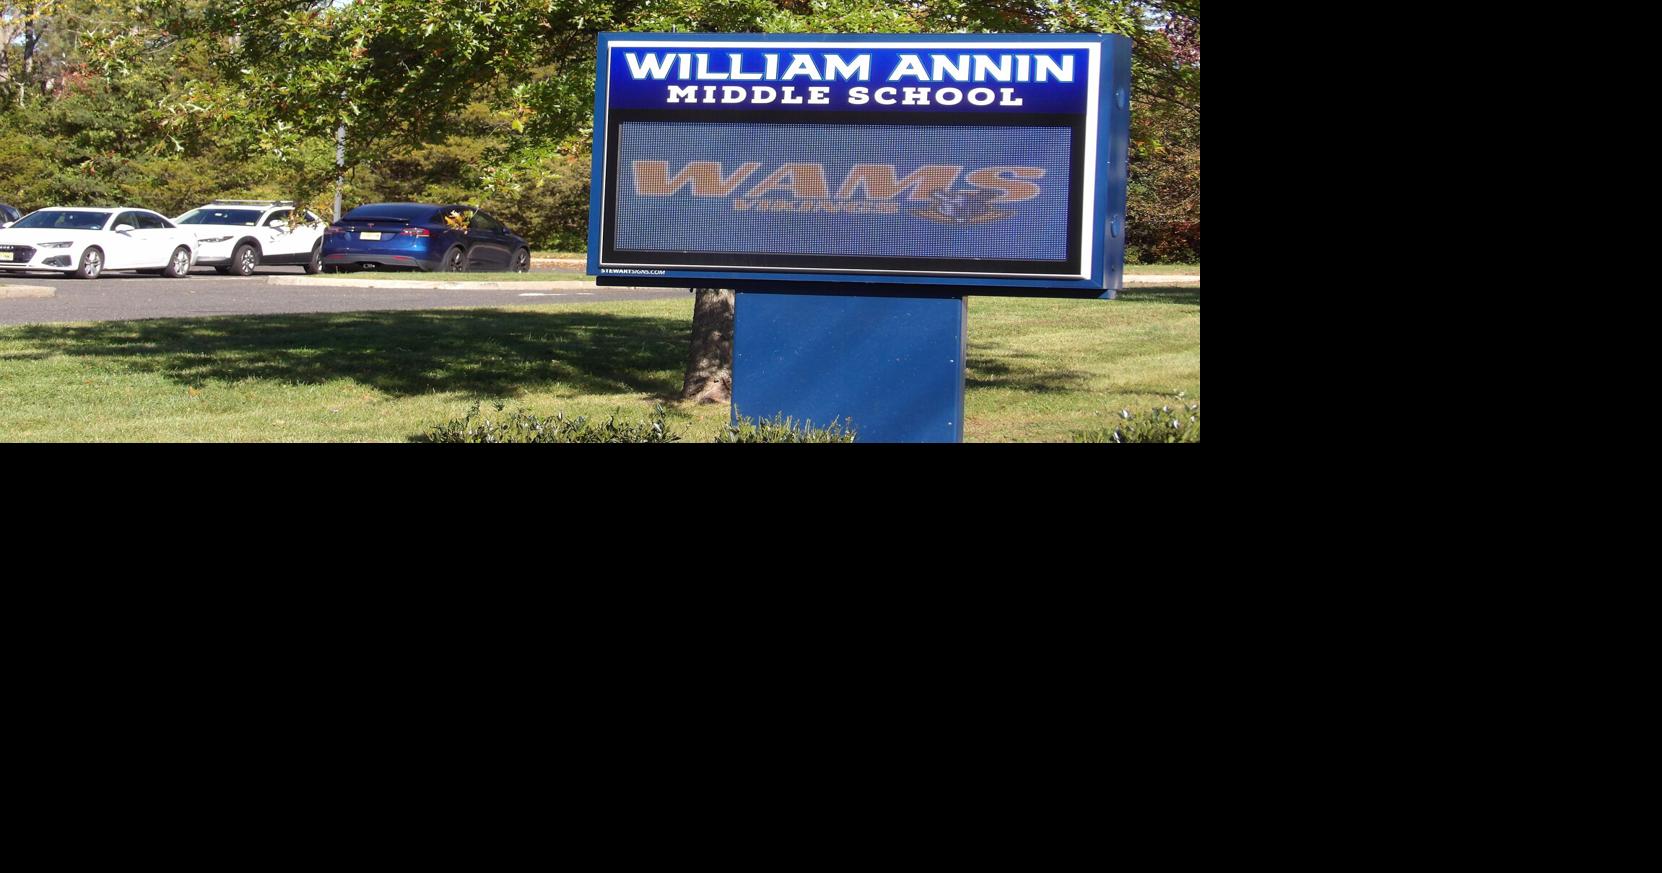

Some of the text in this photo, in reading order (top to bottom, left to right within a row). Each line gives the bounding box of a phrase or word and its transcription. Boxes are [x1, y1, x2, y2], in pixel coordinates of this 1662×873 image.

[625, 52, 1074, 82] WILLIAM ANNIN
[667, 85, 1023, 106] MIDDLE SCHOOL
[631, 159, 1046, 202] WAMS
[733, 198, 899, 214] VIKINGS
